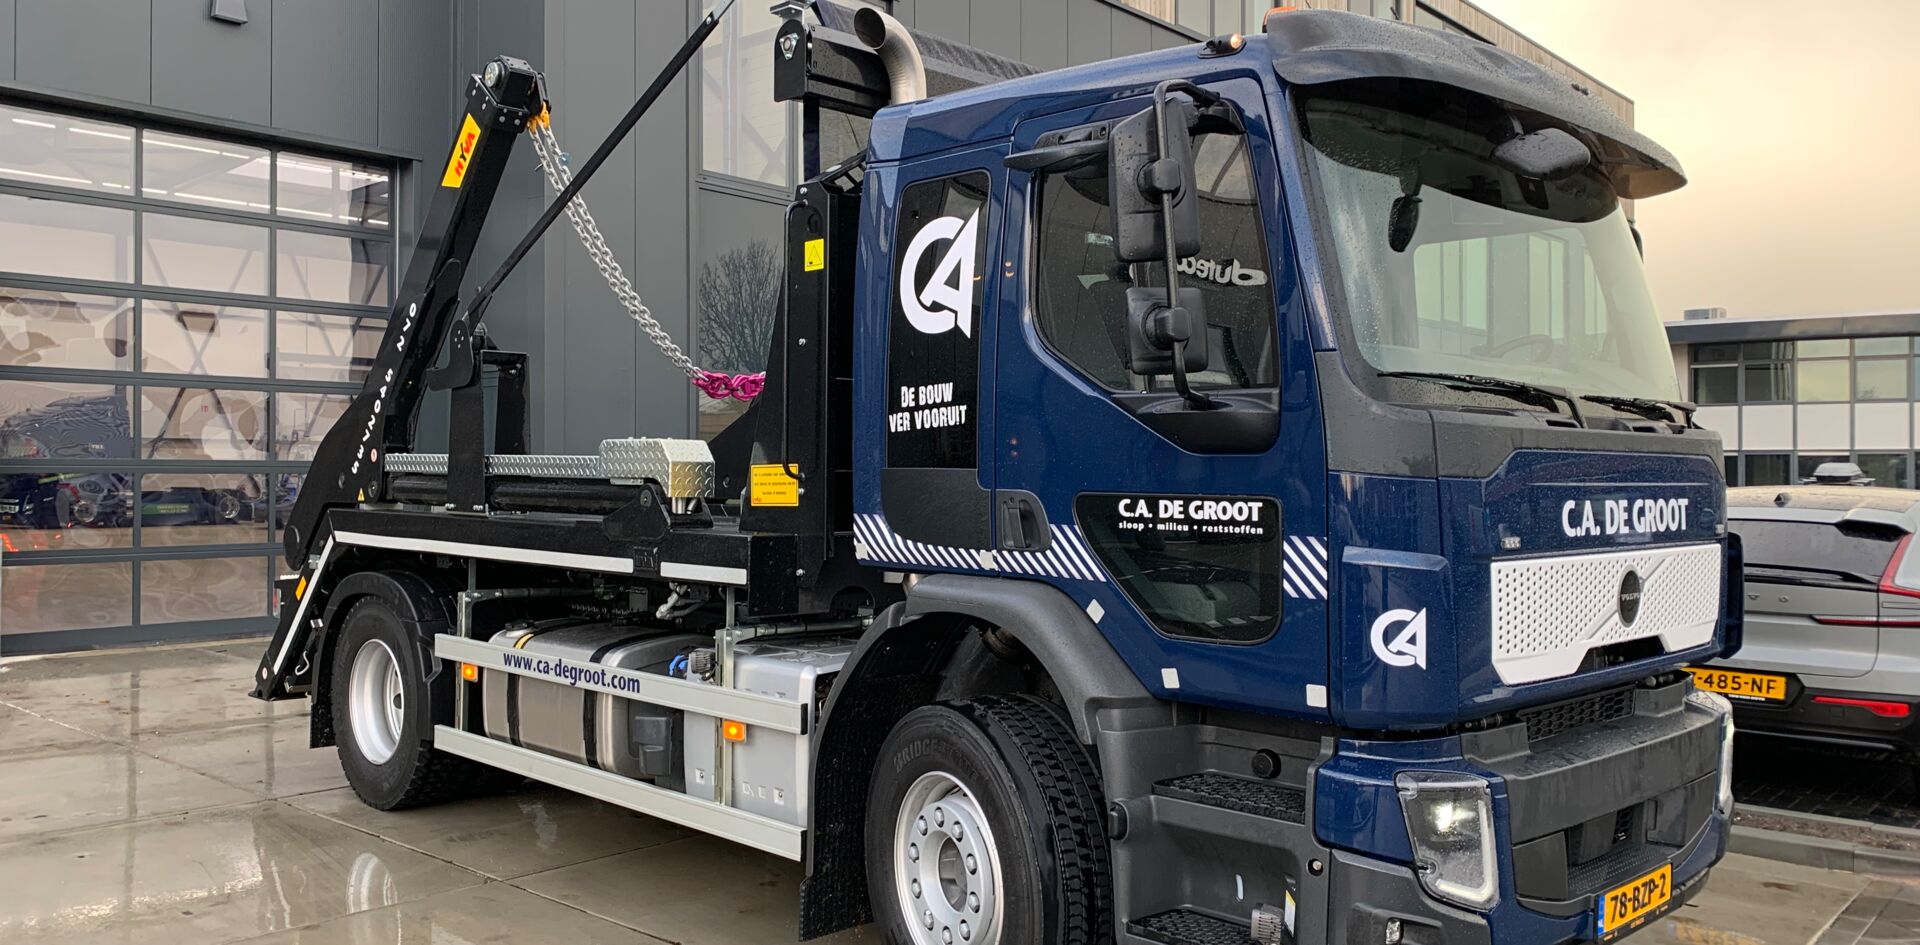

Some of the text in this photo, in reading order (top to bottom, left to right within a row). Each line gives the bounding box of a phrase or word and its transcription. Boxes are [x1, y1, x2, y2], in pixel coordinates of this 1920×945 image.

[454, 132, 476, 178] HYVA
[901, 381, 954, 408] DE BOUW
[889, 411, 911, 433] VER
[1118, 498, 1263, 521] C.A. DE GROOT
[1562, 498, 1689, 537] C.A. DE GROOT
[1118, 520, 1264, 535] sloop milieu reststoffen
[503, 652, 641, 694] www.ca-degroot.com
[1693, 671, 1778, 695] -485-NF
[1610, 873, 1667, 924] 78-BZP-2
